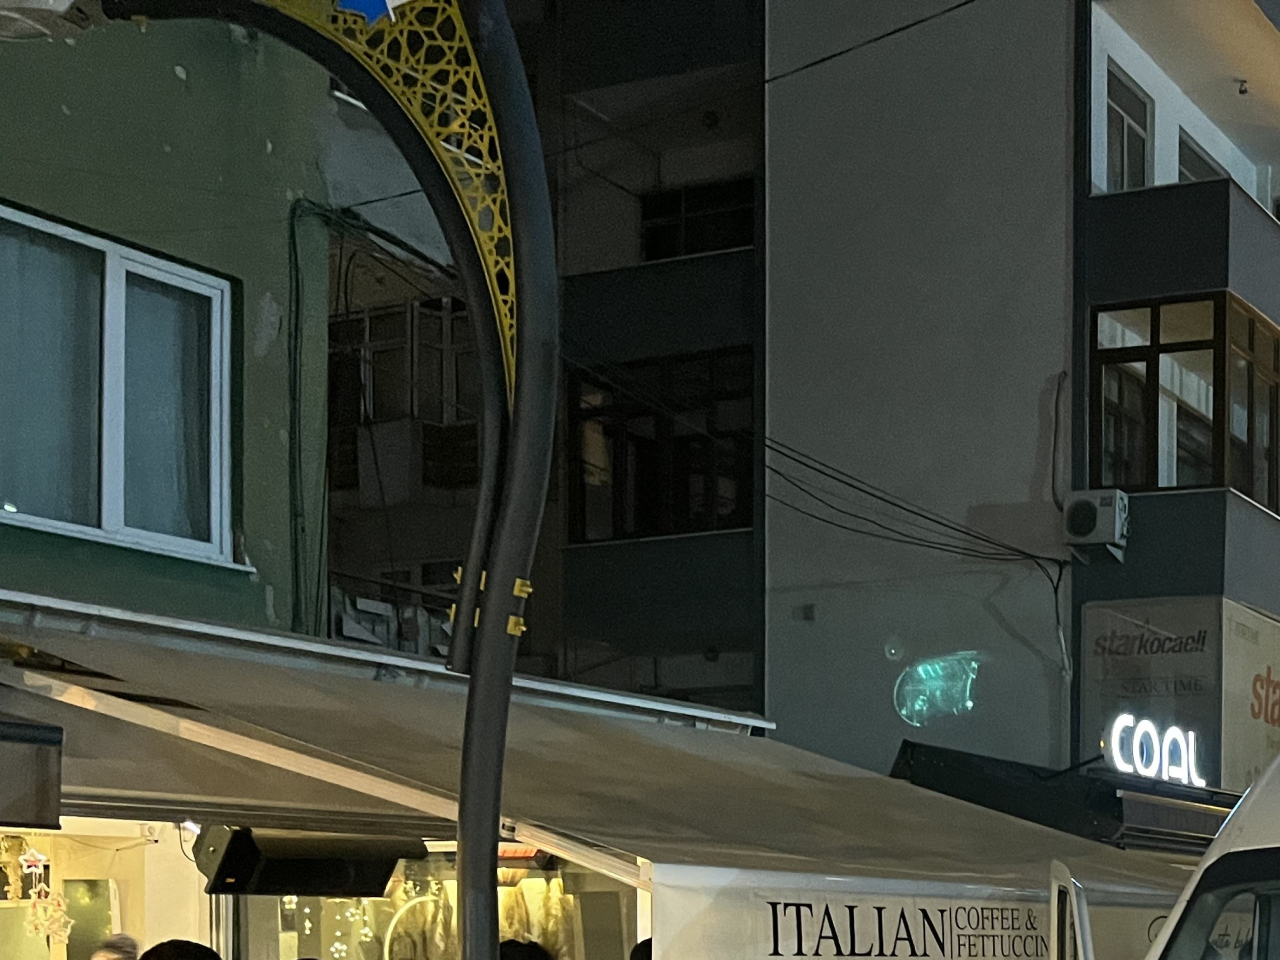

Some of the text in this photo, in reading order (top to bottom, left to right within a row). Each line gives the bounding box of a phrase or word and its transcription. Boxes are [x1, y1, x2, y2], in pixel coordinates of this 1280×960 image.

[1111, 713, 1206, 788] COAL
[766, 901, 948, 958] ITALIAN
[954, 906, 1038, 931] COFFEE &
